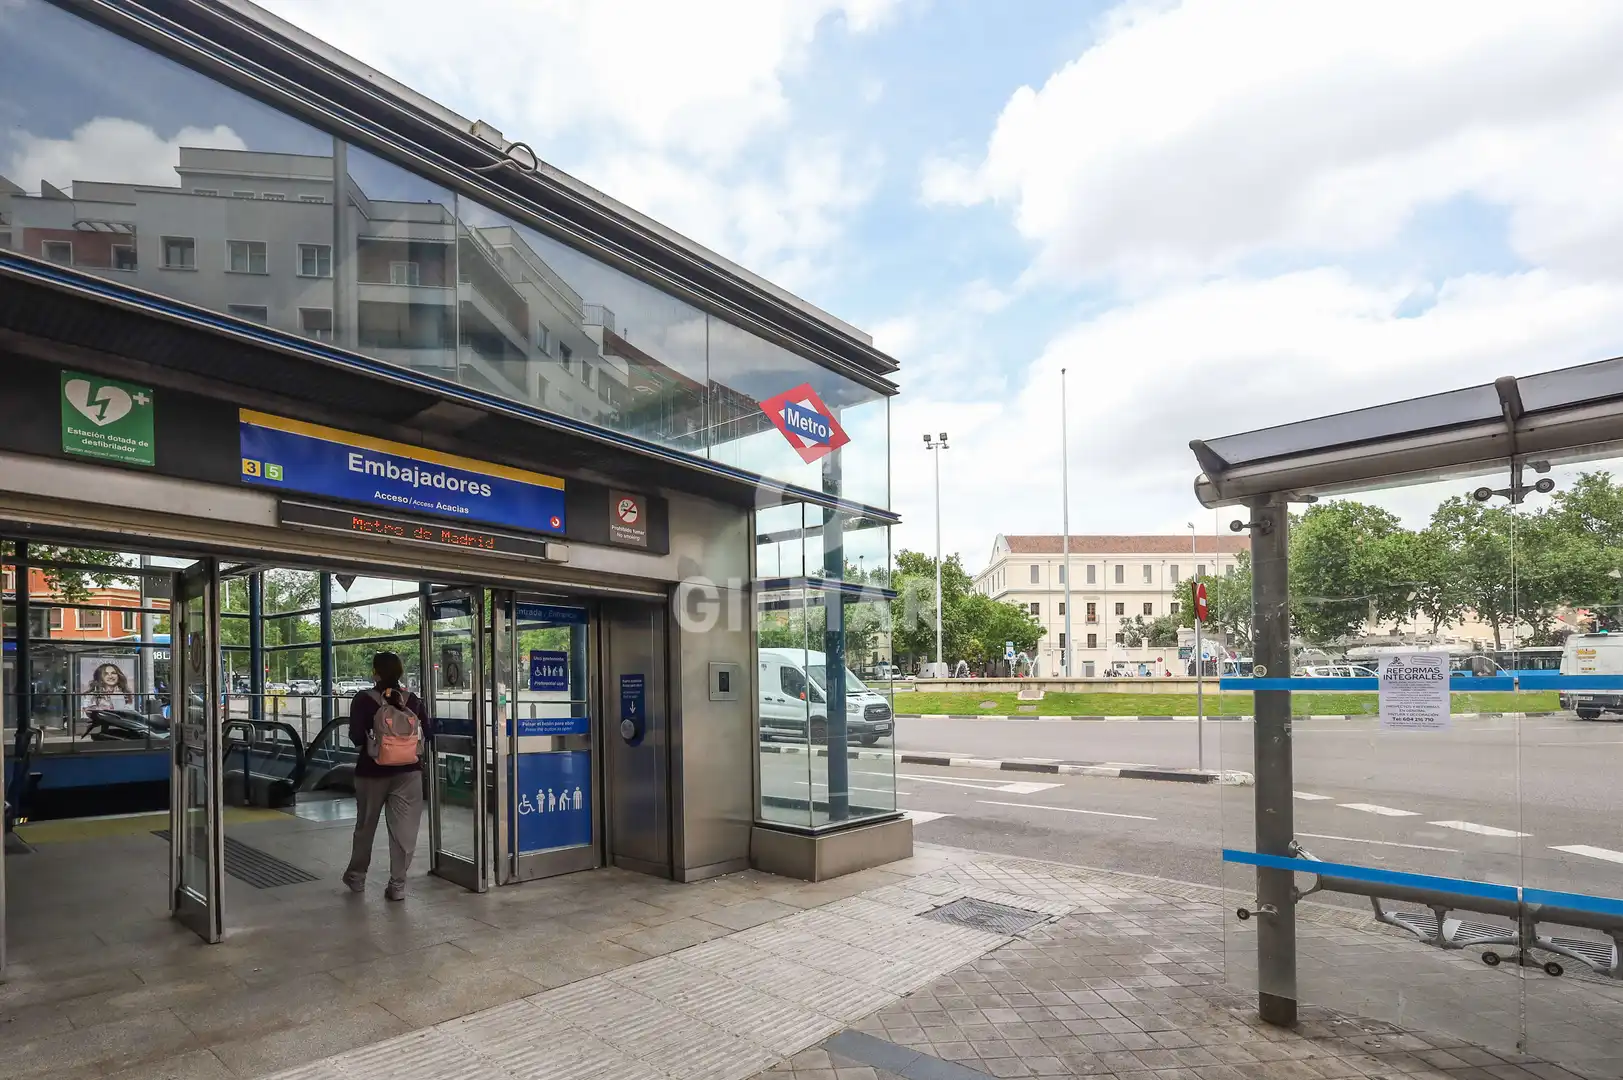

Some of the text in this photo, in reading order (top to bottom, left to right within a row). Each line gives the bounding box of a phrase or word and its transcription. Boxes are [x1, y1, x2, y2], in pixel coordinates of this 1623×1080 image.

[787, 407, 827, 438] Metro
[67, 426, 149, 448] Estación dotada de
[81, 438, 136, 453] desfibrilador
[246, 461, 279, 478] 3 5
[348, 452, 492, 497] Embajadores
[435, 501, 470, 514] Acacias
[352, 516, 494, 549] Metro de Madrid
[163, 652, 171, 660] L
